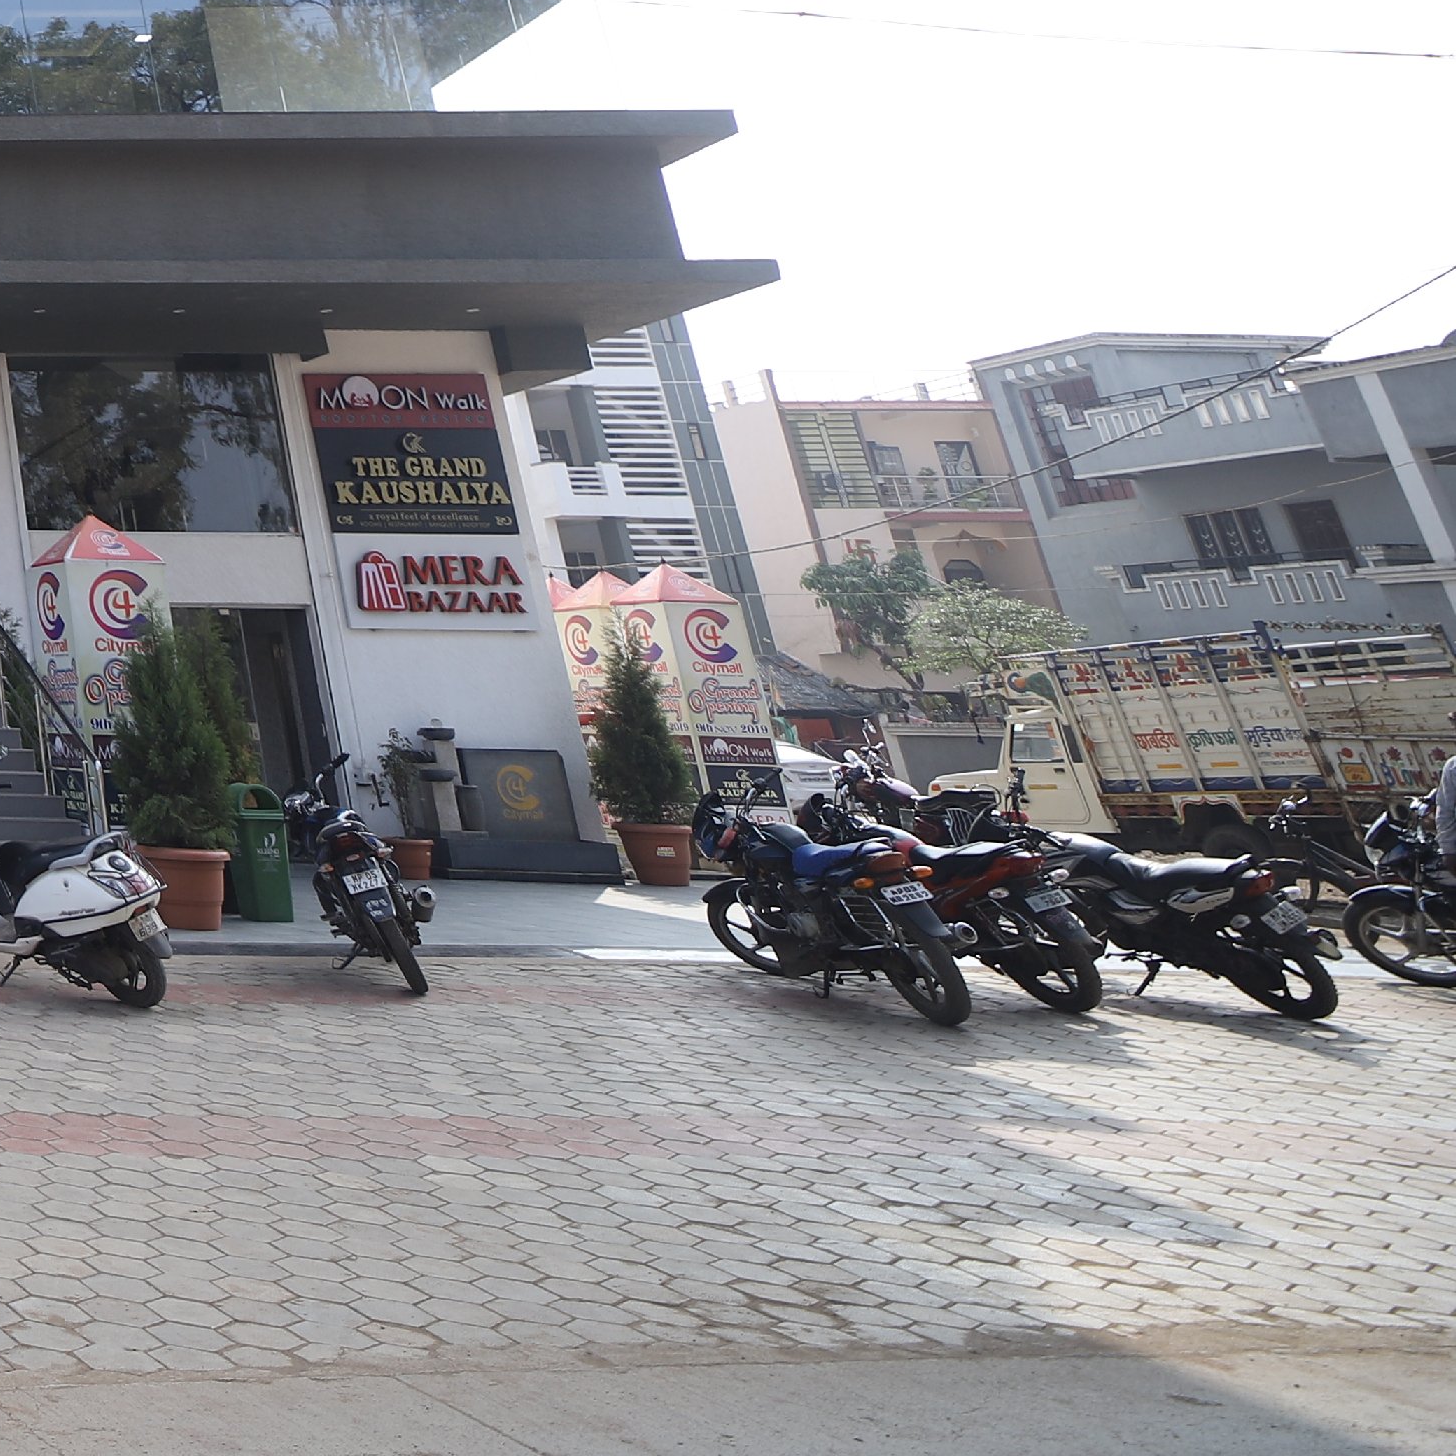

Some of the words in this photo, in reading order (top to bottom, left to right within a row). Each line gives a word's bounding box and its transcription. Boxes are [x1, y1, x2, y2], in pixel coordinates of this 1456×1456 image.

[435, 392, 488, 410] Walk
[352, 457, 400, 477] THE
[405, 457, 488, 477] GRAND
[335, 481, 511, 505] KAUSHALYA
[375, 512, 399, 523] royal
[400, 512, 418, 521] feel
[419, 512, 429, 521] of
[430, 512, 479, 522] excellence
[402, 554, 524, 585] MERA
[407, 590, 529, 613] BAZAAR
[692, 661, 743, 675] Citymall
[702, 677, 760, 700] Grand
[688, 689, 760, 723] Opening
[669, 722, 689, 731] 2019
[696, 723, 714, 733] 9th
[740, 723, 768, 734] 2019
[750, 748, 772, 757] Walk
